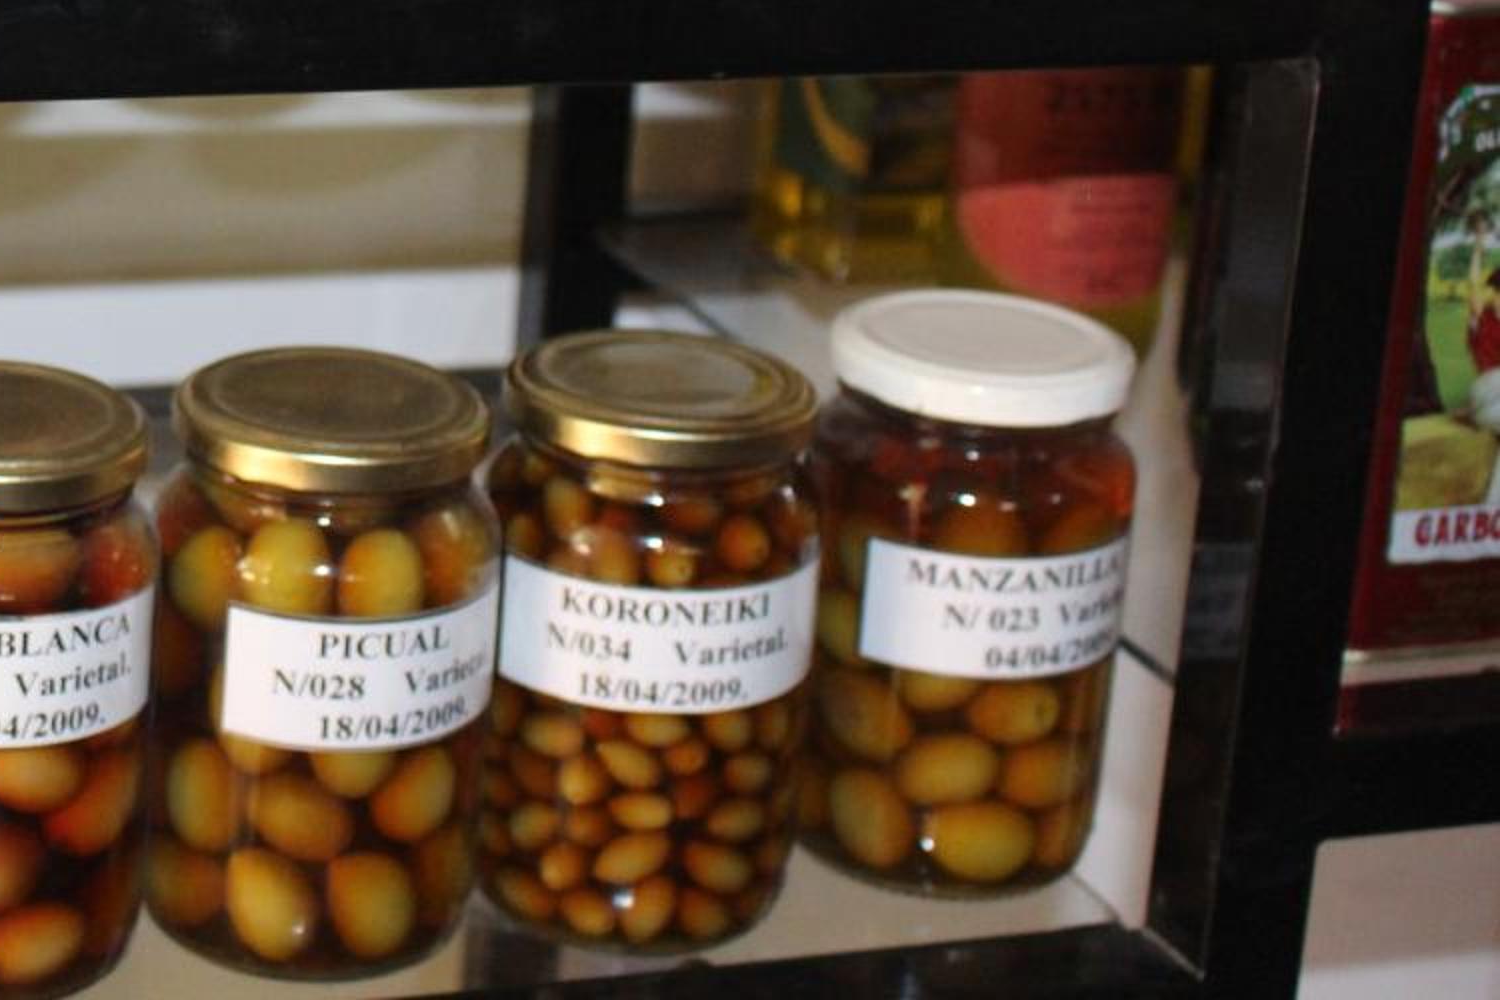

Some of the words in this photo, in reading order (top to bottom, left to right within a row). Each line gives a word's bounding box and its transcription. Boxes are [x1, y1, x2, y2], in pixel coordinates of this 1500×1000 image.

[560, 586, 771, 627] KORONEIKI
[318, 625, 450, 660] PICUAL
[14, 650, 133, 698] Varietal.
[272, 667, 366, 701] N/028
